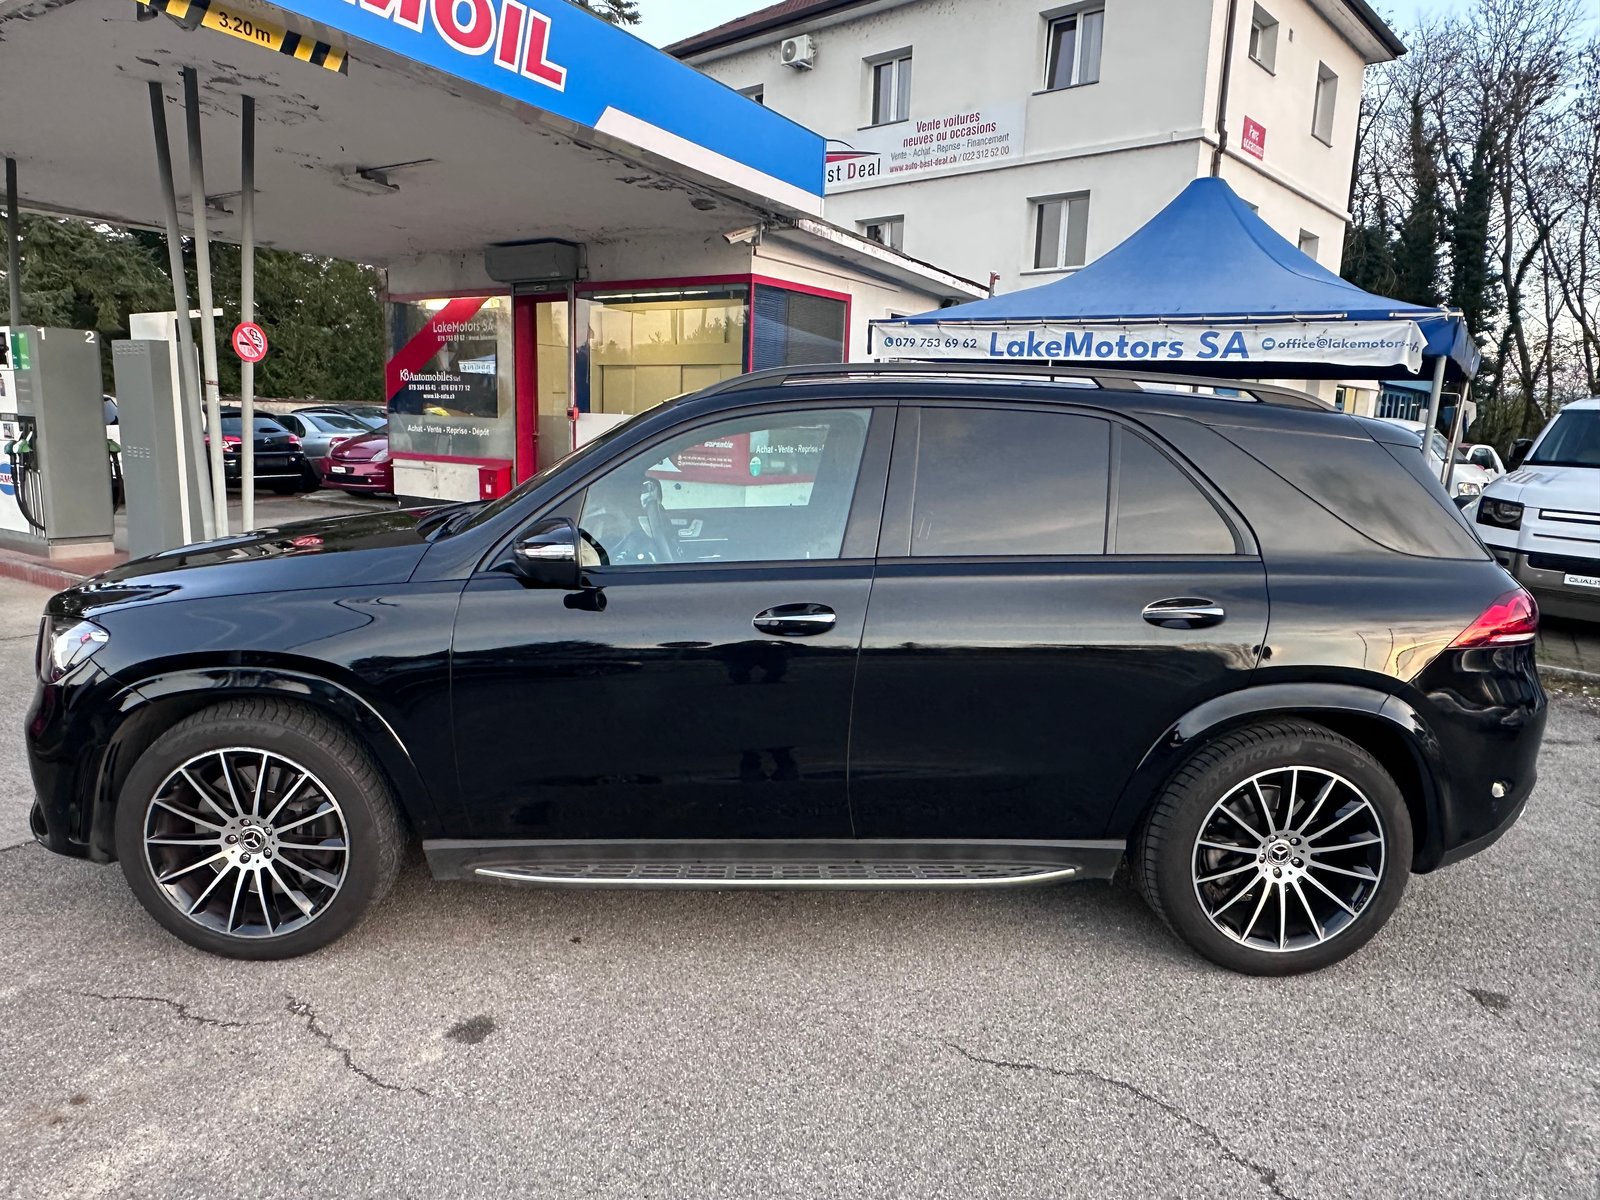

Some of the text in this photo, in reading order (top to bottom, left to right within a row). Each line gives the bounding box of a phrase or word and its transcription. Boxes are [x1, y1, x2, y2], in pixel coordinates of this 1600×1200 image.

[219, 11, 271, 43] 3.20 m
[338, 0, 567, 92] OIL
[916, 111, 981, 133] Vente voitures
[903, 121, 997, 148] neuves ou occasions
[890, 150, 907, 161] Vente
[912, 145, 931, 158] Achat
[936, 142, 961, 154] Reprise
[966, 132, 1010, 148] Financement
[847, 158, 881, 179] Deal
[889, 154, 957, 173] www.auto-best-deal.ch
[962, 152, 975, 162] 022
[976, 149, 990, 159] 312
[990, 147, 999, 157] 52
[1000, 145, 1010, 155] 00
[37, 327, 46, 340] 1
[85, 330, 95, 344] 2
[432, 320, 480, 333] LakeMotors
[895, 337, 916, 348] 079
[919, 337, 941, 348] 753
[944, 337, 958, 348] 69
[962, 337, 977, 349] 62
[989, 330, 1184, 359] LakeMotors
[1196, 330, 1250, 359] SA
[407, 424, 423, 433] Achat
[755, 445, 774, 454] Achat
